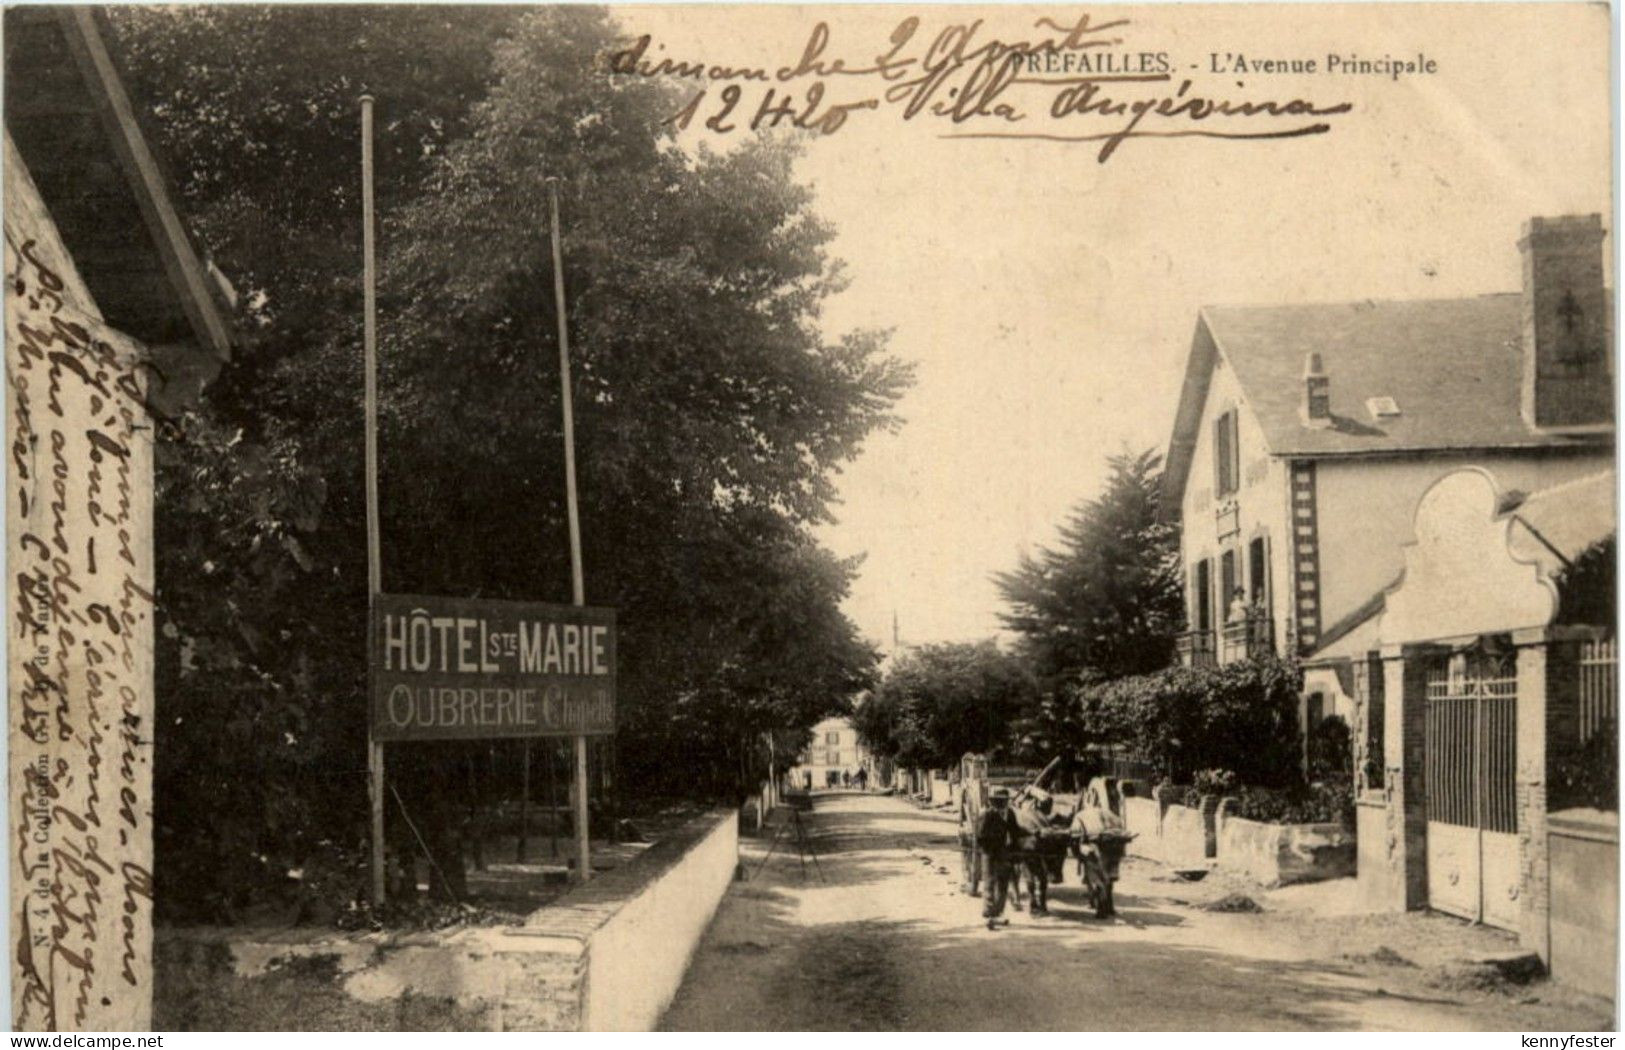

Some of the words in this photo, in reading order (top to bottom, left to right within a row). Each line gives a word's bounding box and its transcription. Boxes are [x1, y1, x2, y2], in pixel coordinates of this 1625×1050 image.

[384, 608, 500, 673] HÔTEL
[519, 621, 609, 675] MARIE
[388, 684, 537, 727] OUBRERIE
